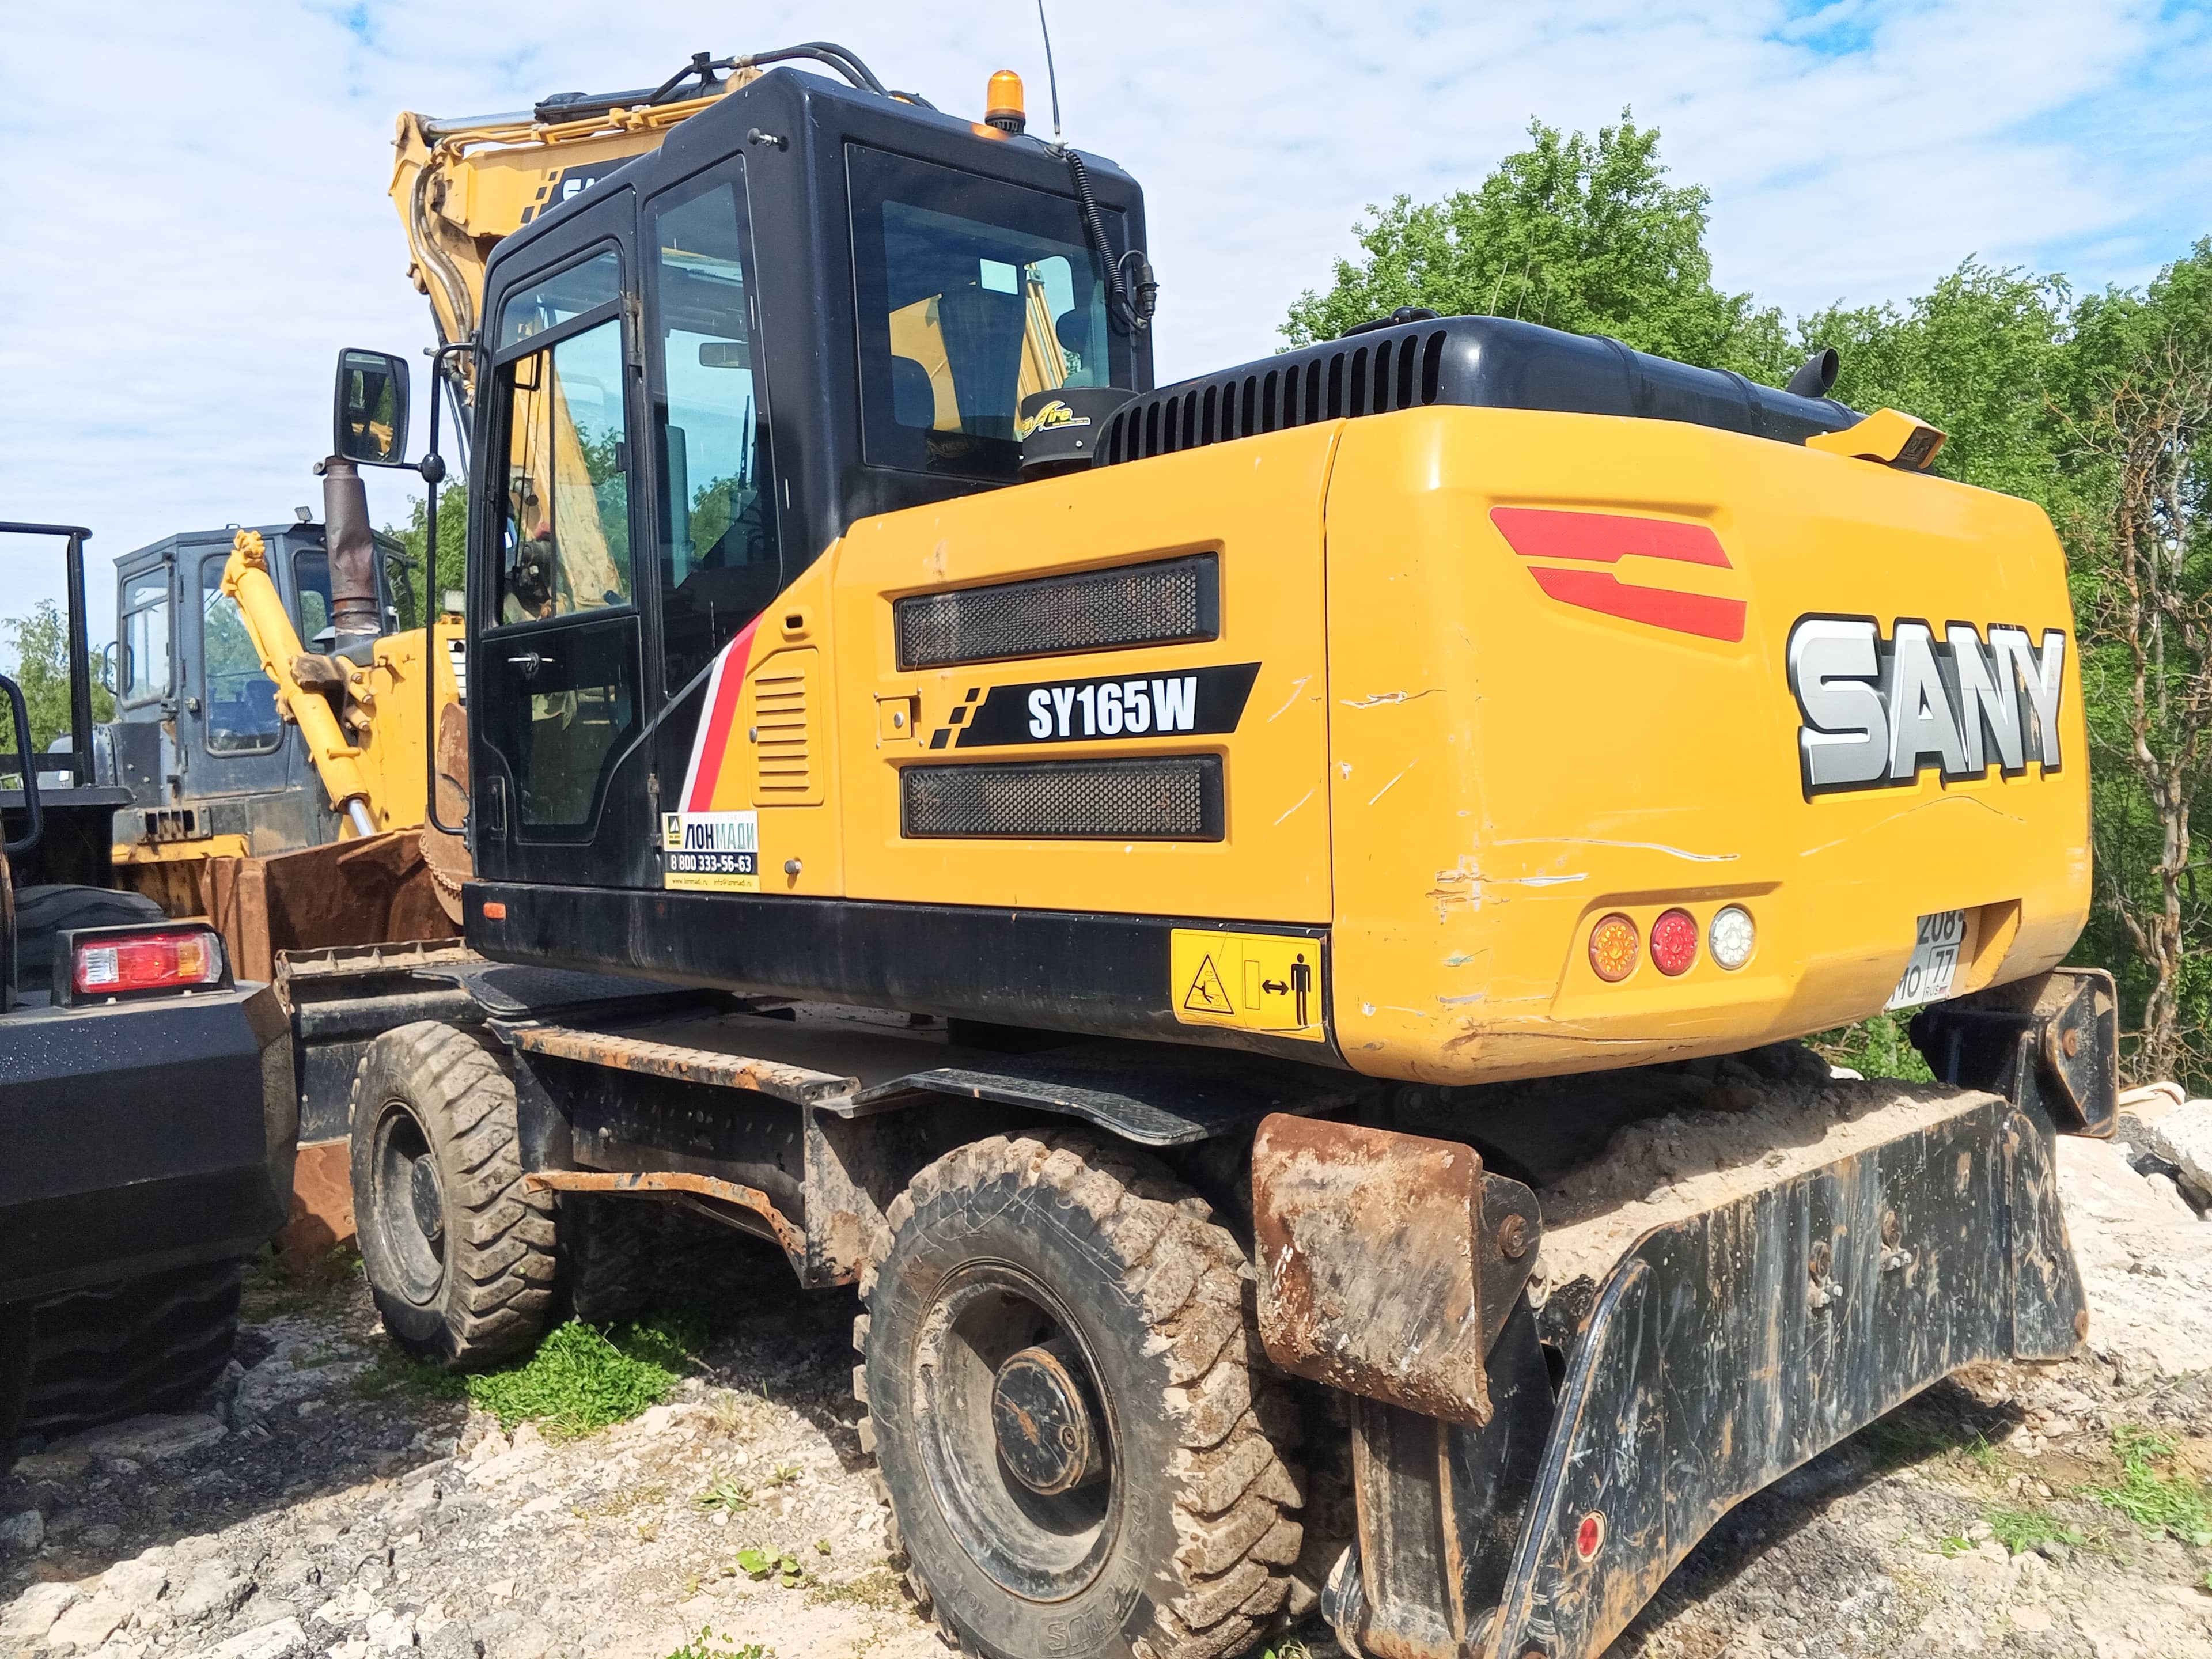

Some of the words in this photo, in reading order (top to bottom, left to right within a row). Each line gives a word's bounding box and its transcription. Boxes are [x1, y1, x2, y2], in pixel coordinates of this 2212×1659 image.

[1028, 676, 1198, 739] SY165W
[1788, 615, 2066, 788] SANY
[685, 823, 755, 850] ЛОНМАДИ
[671, 855, 677, 870] 8
[679, 855, 696, 871] 800
[698, 855, 752, 872] 333-56-63
[1933, 949, 1954, 983] 77
[1926, 984, 1940, 997] RUS
